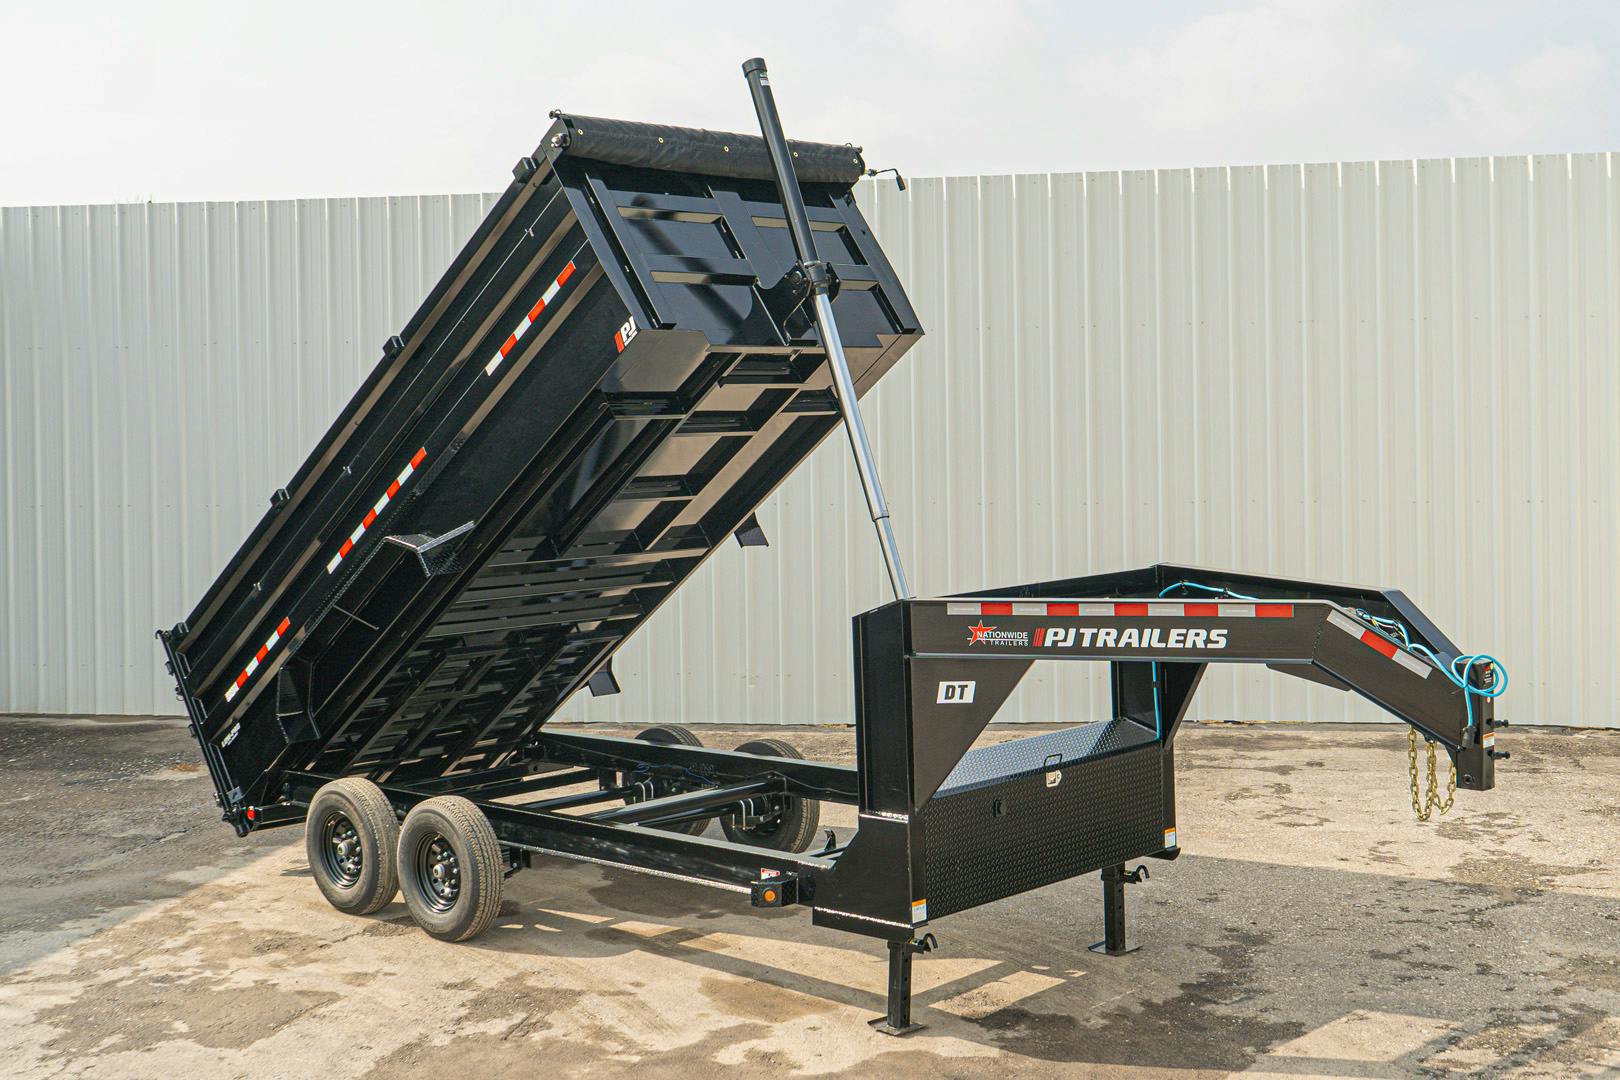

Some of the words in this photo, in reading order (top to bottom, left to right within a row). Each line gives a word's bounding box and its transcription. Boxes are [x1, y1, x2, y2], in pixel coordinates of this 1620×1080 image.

[620, 316, 637, 343] PJ
[977, 631, 1029, 639] NATIONWIDE
[1044, 627, 1076, 648] PJ
[1079, 627, 1228, 649] TRAILERS
[944, 684, 969, 701] DT
